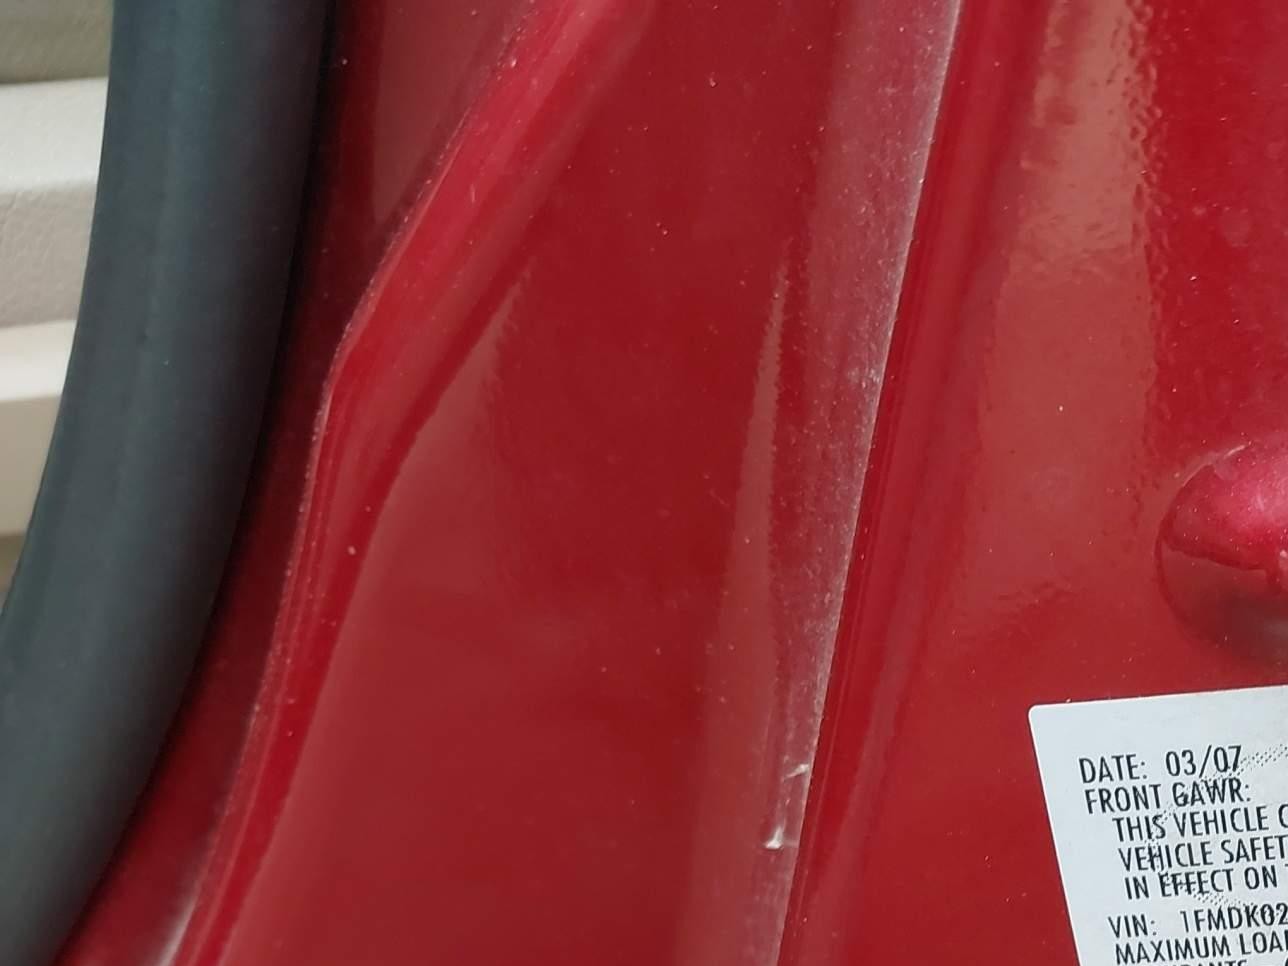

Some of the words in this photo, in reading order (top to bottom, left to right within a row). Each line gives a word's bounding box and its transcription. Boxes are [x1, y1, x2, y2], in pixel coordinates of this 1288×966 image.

[1079, 755, 1147, 784] DATE:
[1165, 745, 1242, 778] 03/07
[1085, 785, 1164, 815] FRONT
[1173, 778, 1252, 806] GAWR:
[1112, 814, 1166, 842] THIS
[1173, 806, 1267, 837] VEHICLE
[1119, 840, 1214, 871] VEHICLE
[1125, 875, 1149, 900] IN
[1158, 868, 1235, 897] EFFECT
[1244, 863, 1278, 890] ON
[1108, 915, 1157, 939] VIN:
[1115, 938, 1230, 965] MAXIMUM
